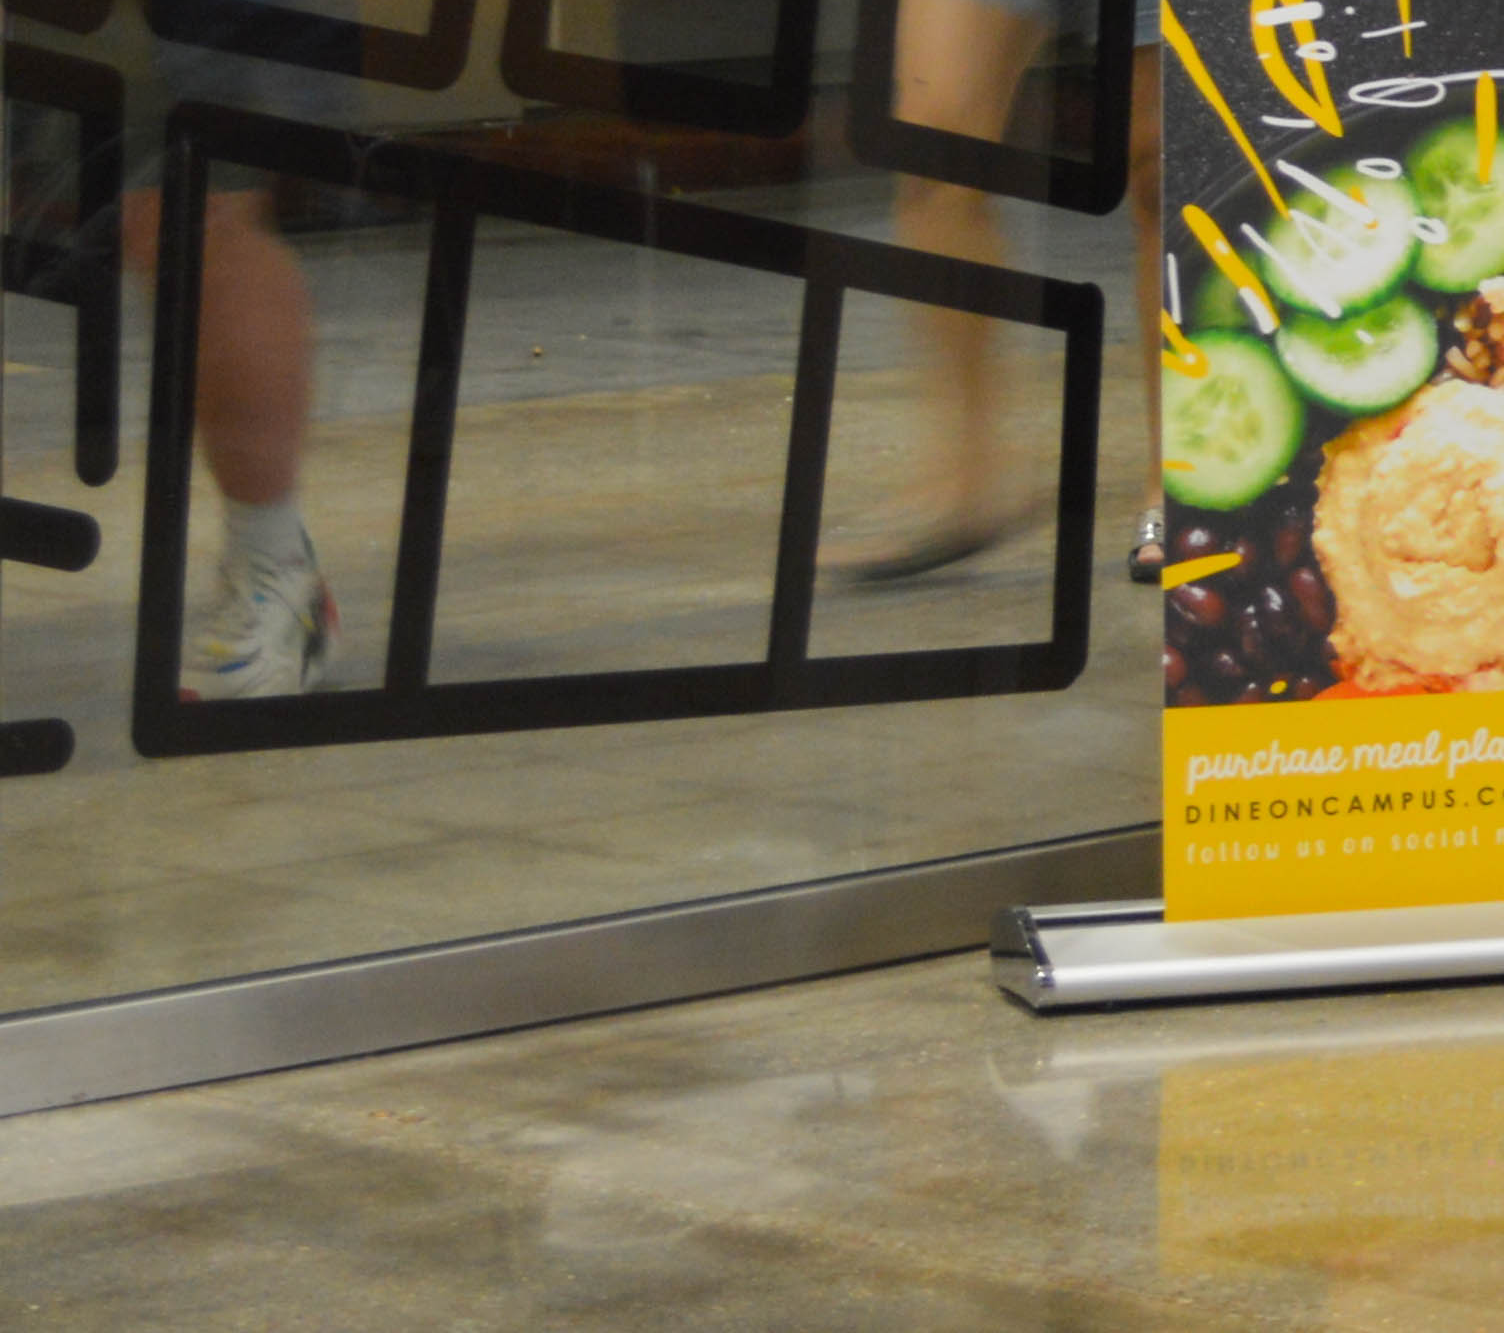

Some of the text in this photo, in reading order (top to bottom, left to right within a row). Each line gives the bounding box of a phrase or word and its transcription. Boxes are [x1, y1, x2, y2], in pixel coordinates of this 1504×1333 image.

[1186, 739, 1348, 796] purchase
[1352, 729, 1444, 771] meal
[1187, 841, 1280, 865] follow
[1297, 838, 1326, 859] us
[1343, 836, 1374, 855] on
[1391, 827, 1480, 852] social
